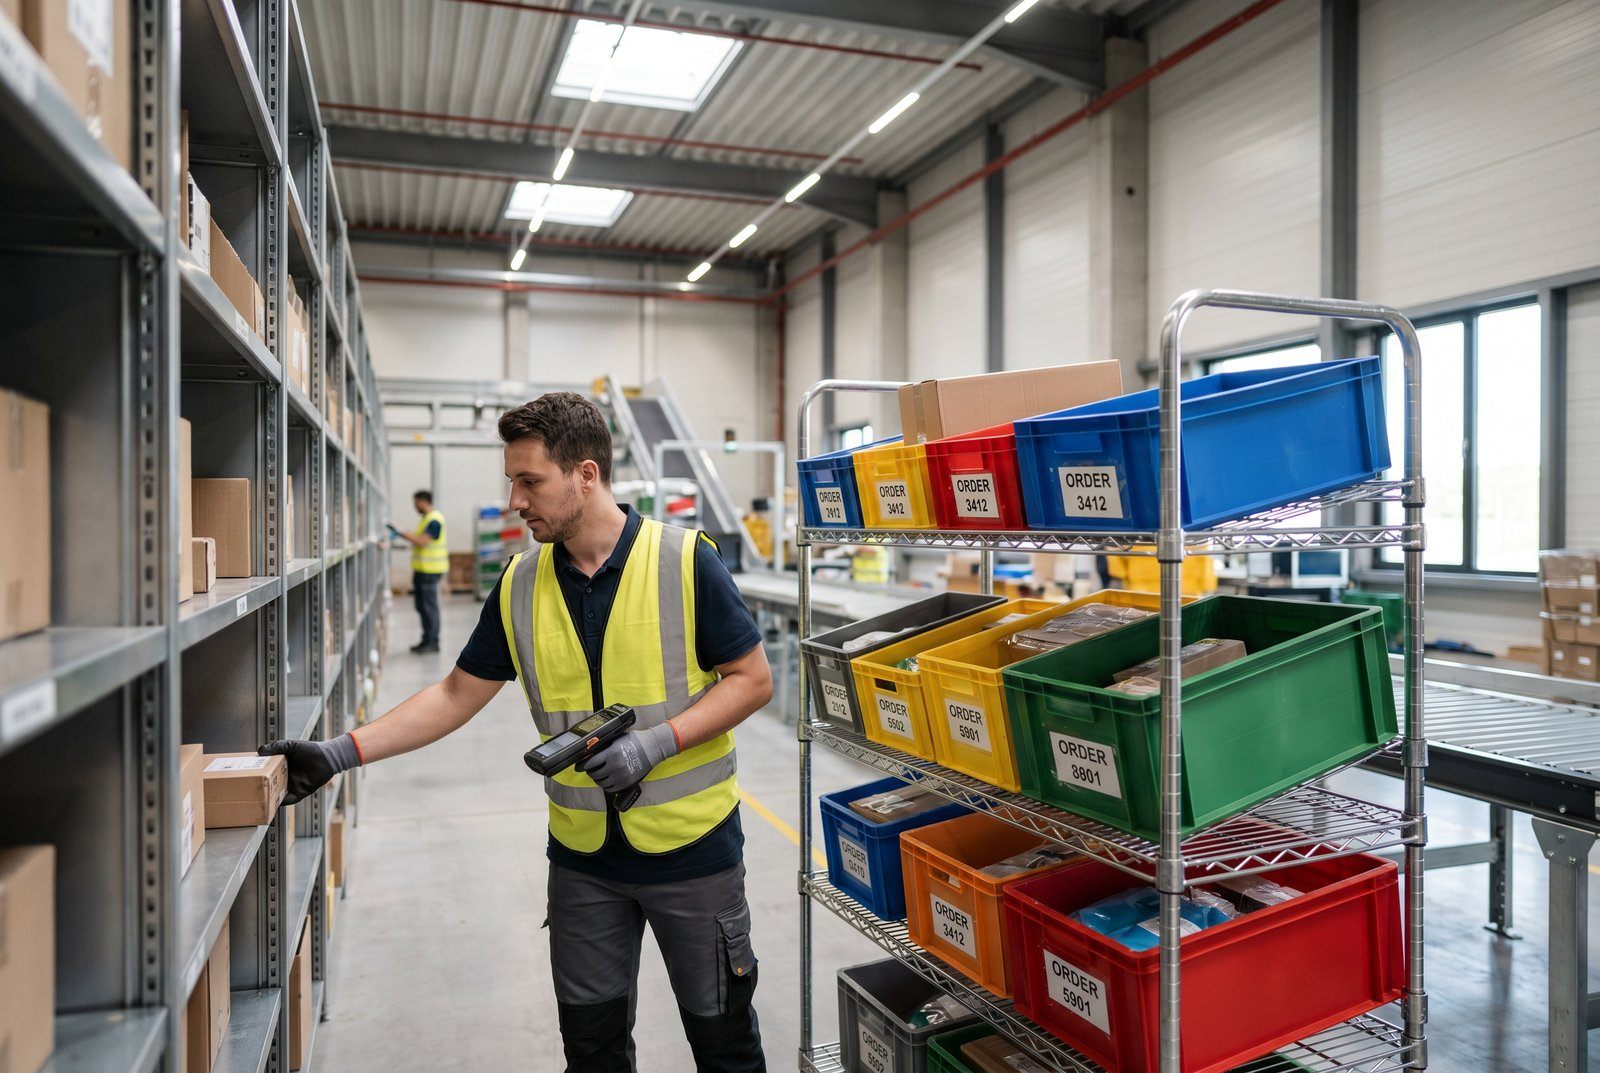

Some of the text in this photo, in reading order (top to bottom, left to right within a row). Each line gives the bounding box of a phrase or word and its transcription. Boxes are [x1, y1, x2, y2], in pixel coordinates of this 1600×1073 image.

[879, 485, 906, 497] ORDER
[957, 479, 991, 493] ORDER
[1066, 473, 1111, 488] ORDER
[819, 492, 842, 502] ORDER
[965, 499, 988, 512] 3412
[1077, 496, 1107, 511] 3412
[879, 698, 908, 717] ORDER
[949, 704, 983, 726] ORDER
[1058, 739, 1107, 766] ORDER
[1071, 764, 1101, 786] 8801
[841, 841, 867, 864] ORDER
[935, 901, 969, 930] ORDER
[943, 923, 965, 946] 3412
[1052, 960, 1099, 999] ORDER
[1063, 987, 1091, 1016] 5901
[862, 1031, 888, 1062] ORDER
